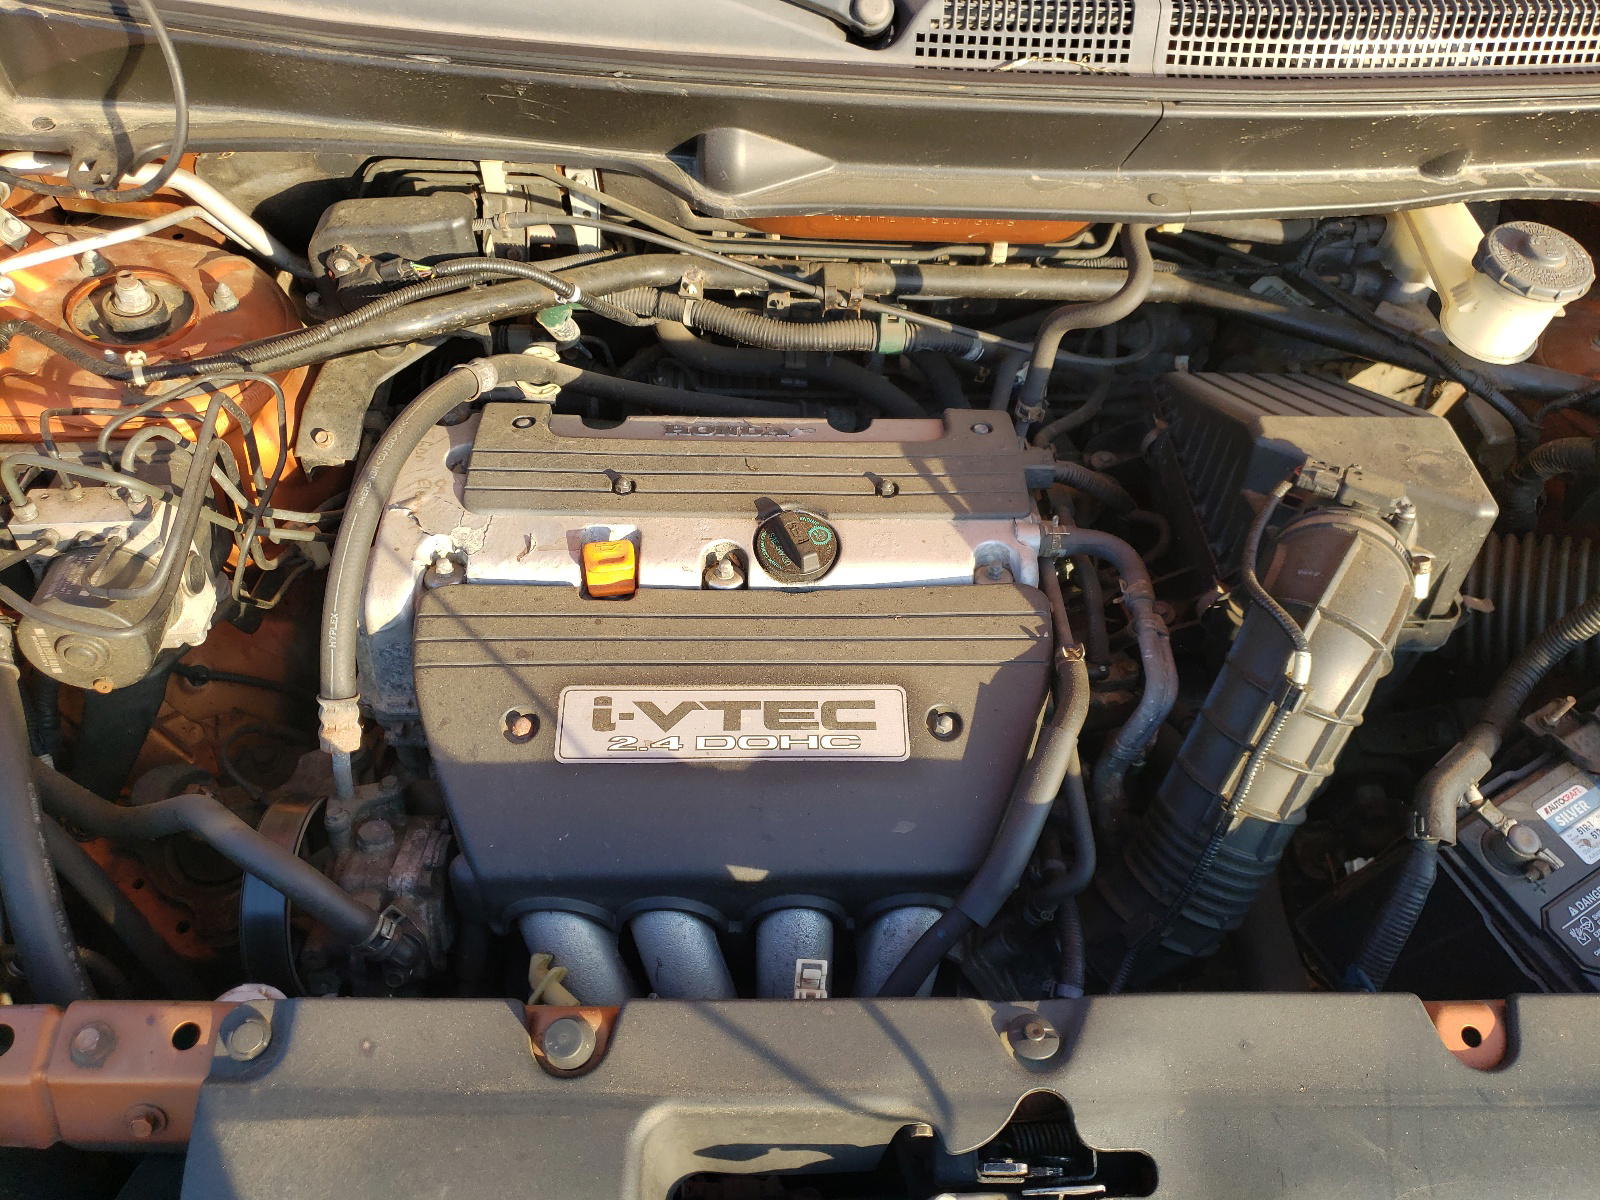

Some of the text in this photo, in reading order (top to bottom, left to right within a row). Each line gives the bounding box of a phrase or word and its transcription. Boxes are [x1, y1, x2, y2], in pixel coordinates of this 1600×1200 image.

[591, 696, 877, 733] i-VTEC
[607, 735, 861, 751] 2.4 DOHC
[1547, 787, 1581, 813] AUTOCRAFT
[1554, 801, 1591, 827] SILVER
